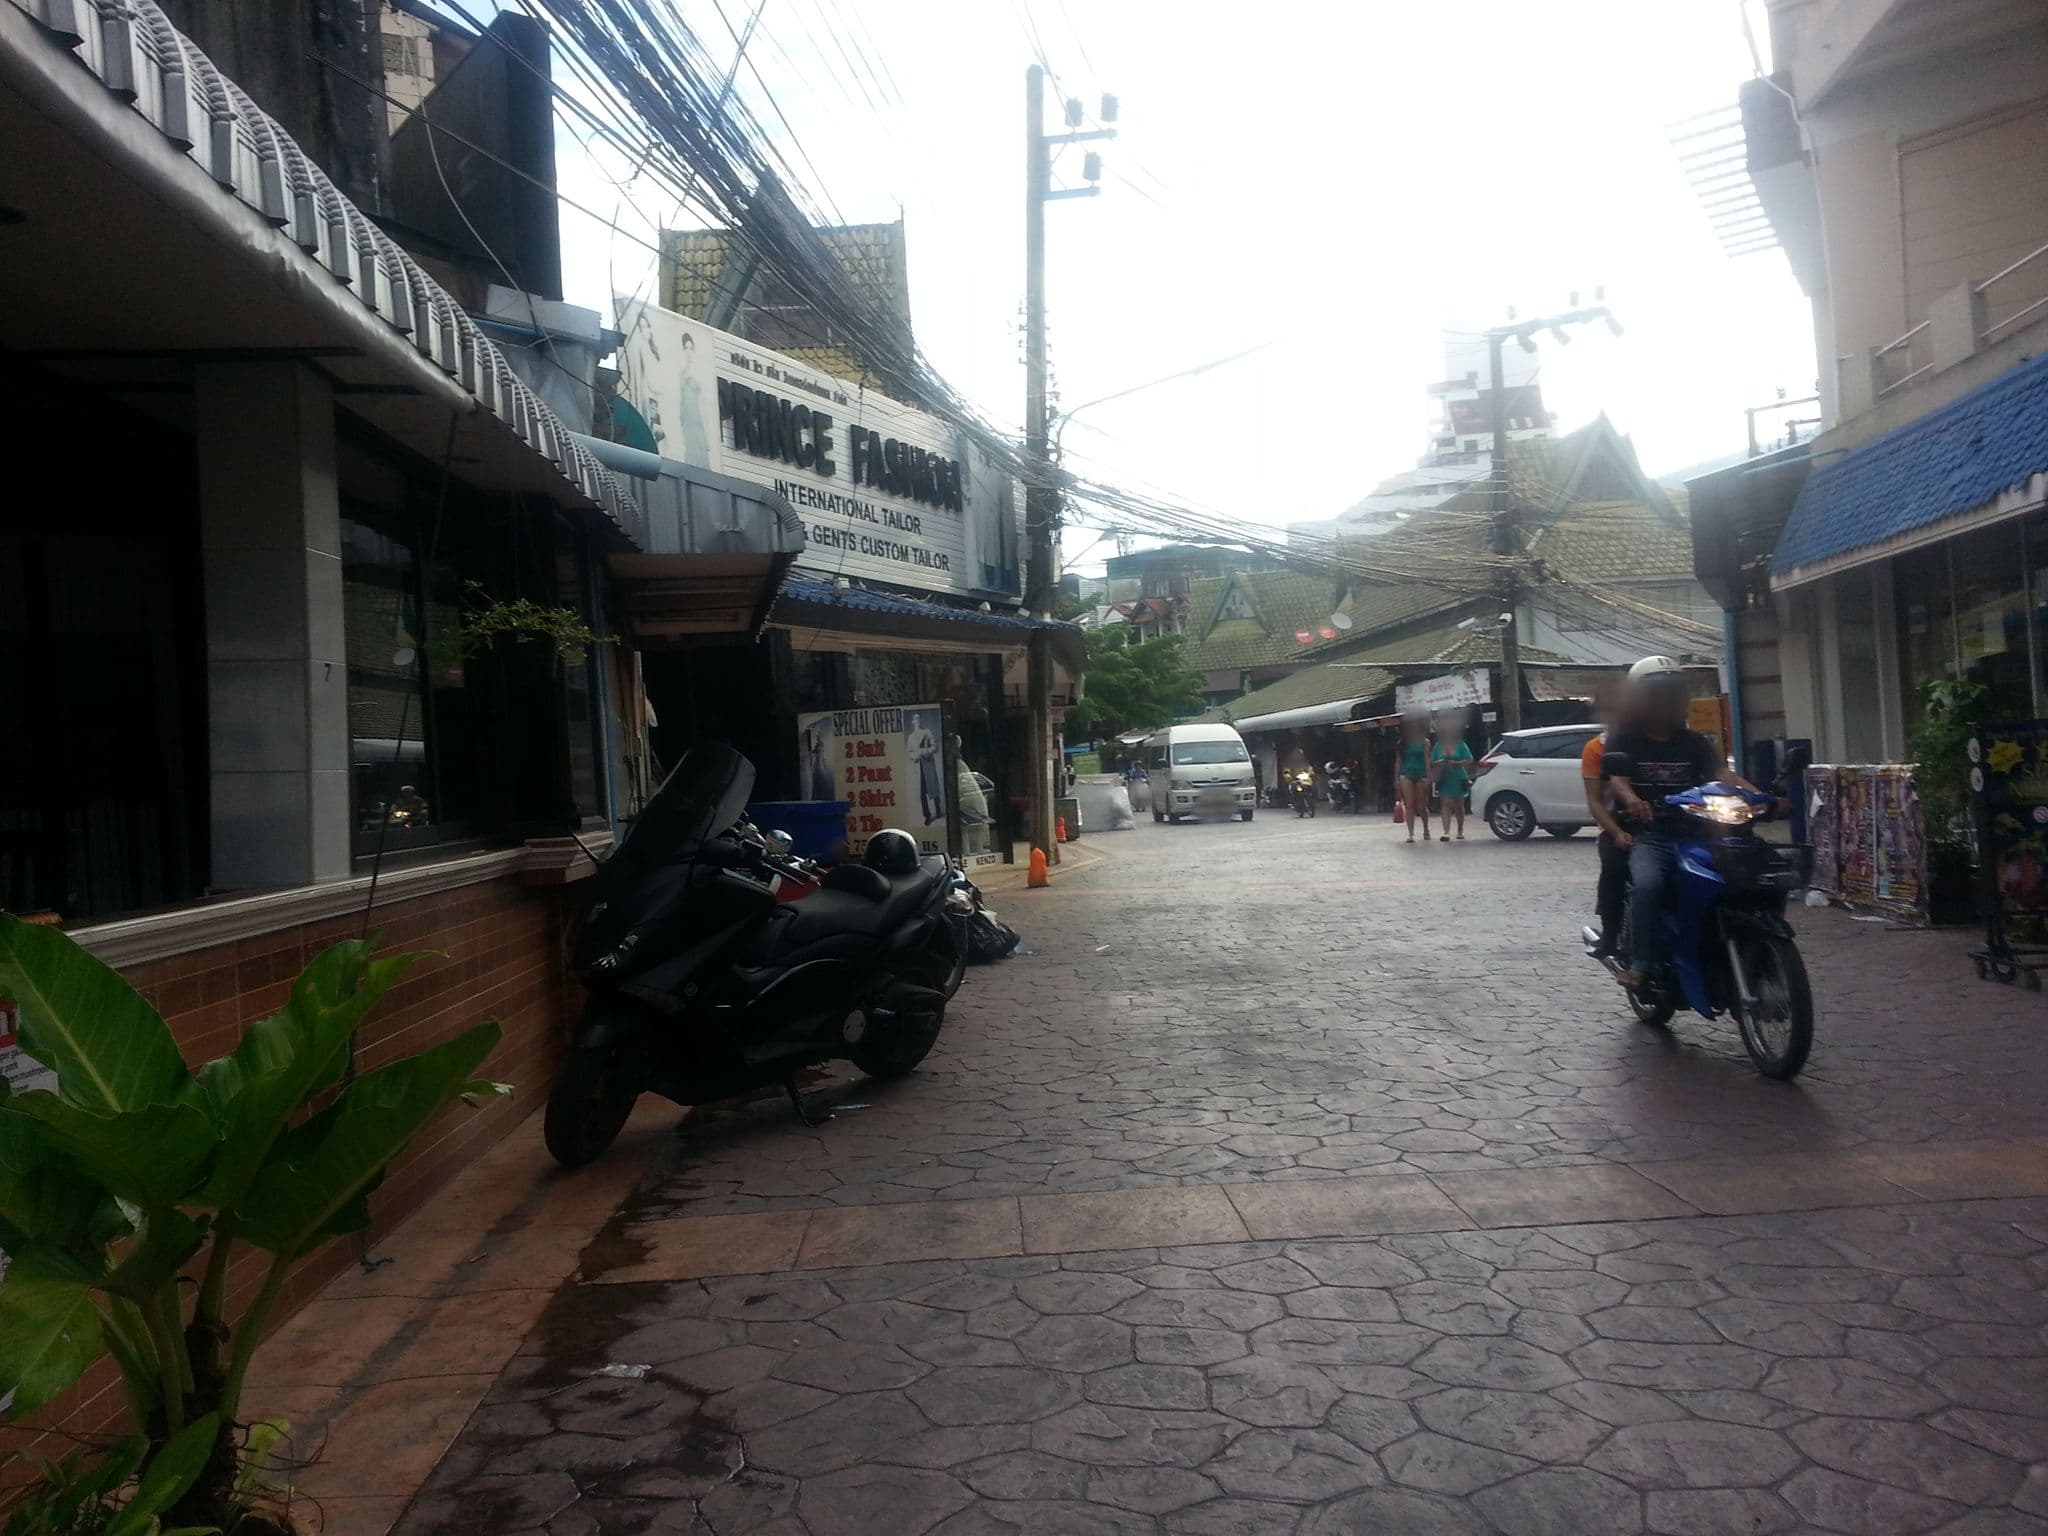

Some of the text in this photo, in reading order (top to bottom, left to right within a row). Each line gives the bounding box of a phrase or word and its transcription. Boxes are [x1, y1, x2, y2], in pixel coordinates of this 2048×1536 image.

[717, 376, 836, 476] PRINCE
[774, 479, 921, 535] INTERNATIONAL TAILOR
[813, 524, 950, 572] GENTS CUSTOM TAILOR
[833, 708, 904, 736] SPECIAL OFFER
[845, 739, 886, 758] 2 Suit
[846, 764, 893, 783] 2 Pant
[847, 789, 896, 808] 2 Shirt
[848, 814, 883, 832] 2 Tie
